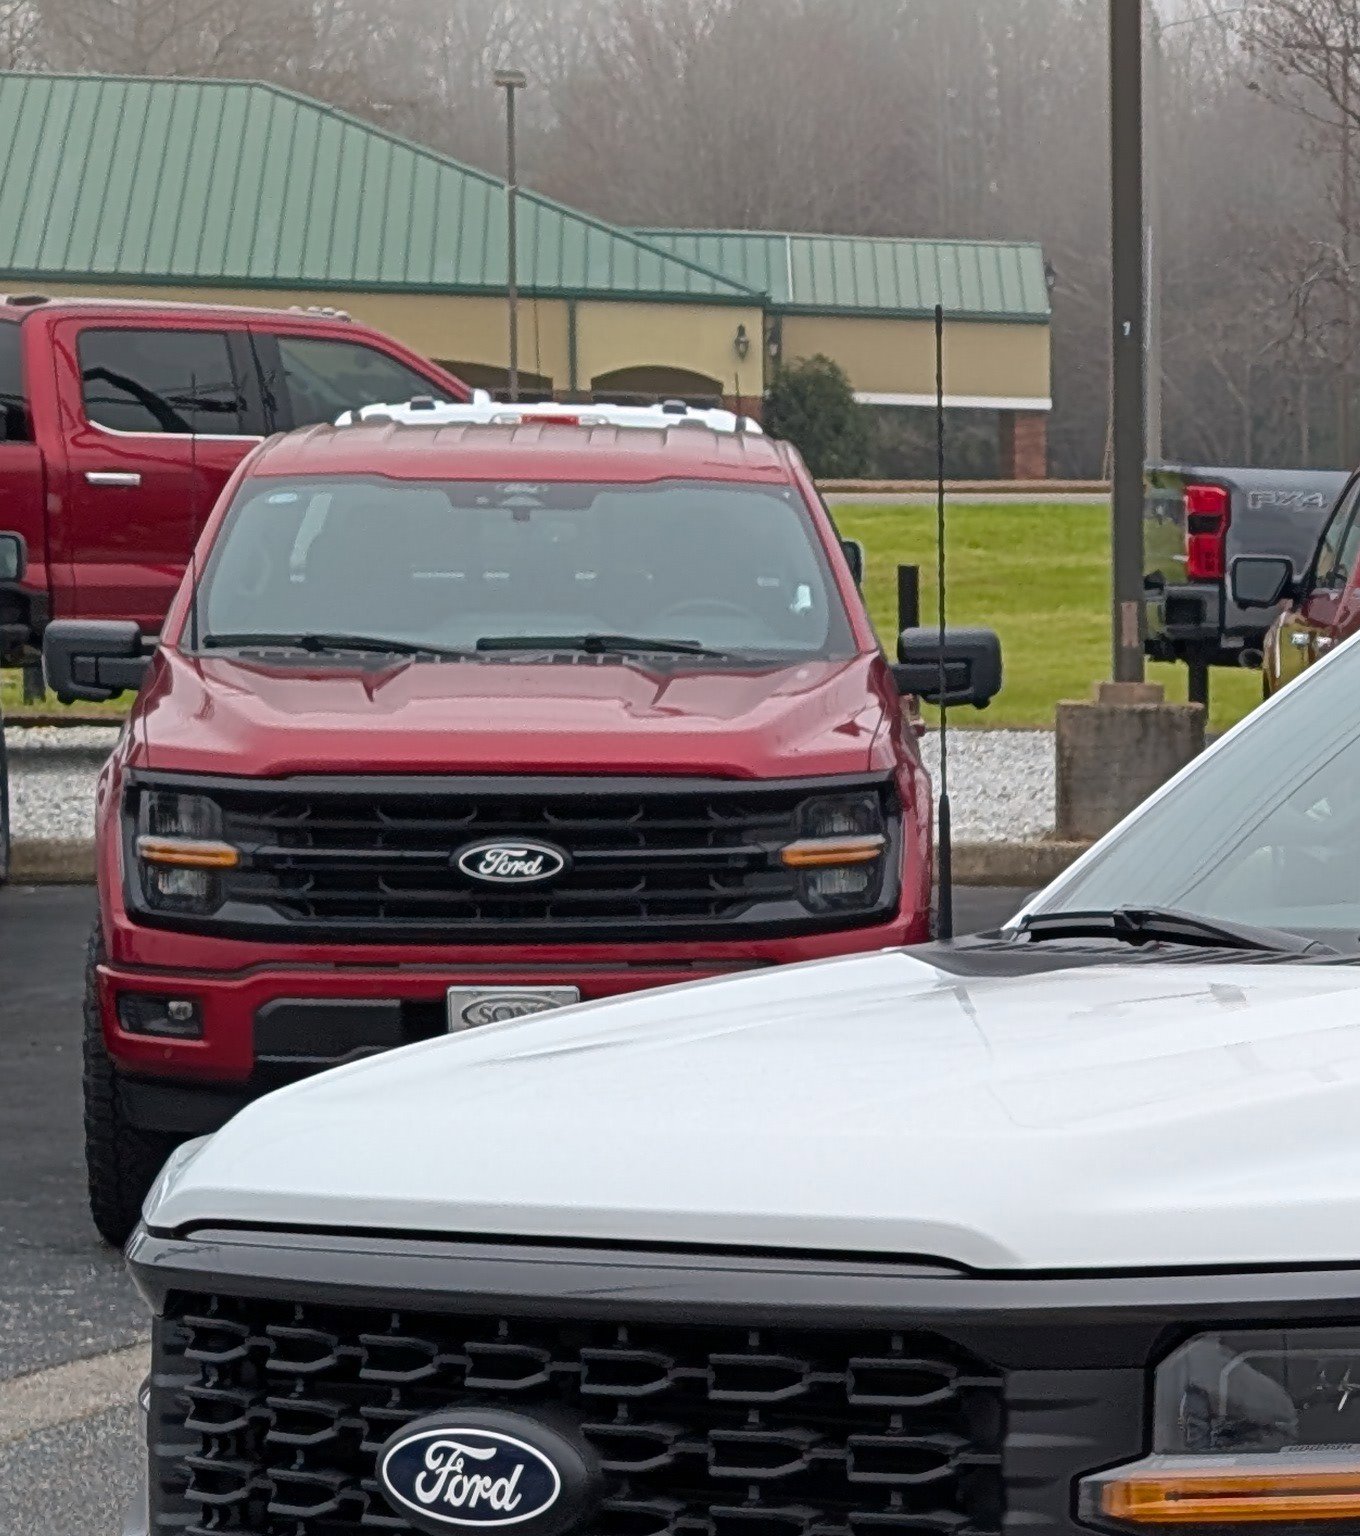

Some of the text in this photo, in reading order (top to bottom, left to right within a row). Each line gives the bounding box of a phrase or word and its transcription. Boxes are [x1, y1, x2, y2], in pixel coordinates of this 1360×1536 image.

[478, 849, 544, 876] Ford
[478, 1002, 547, 1023] SO
[414, 1440, 525, 1512] Ford
